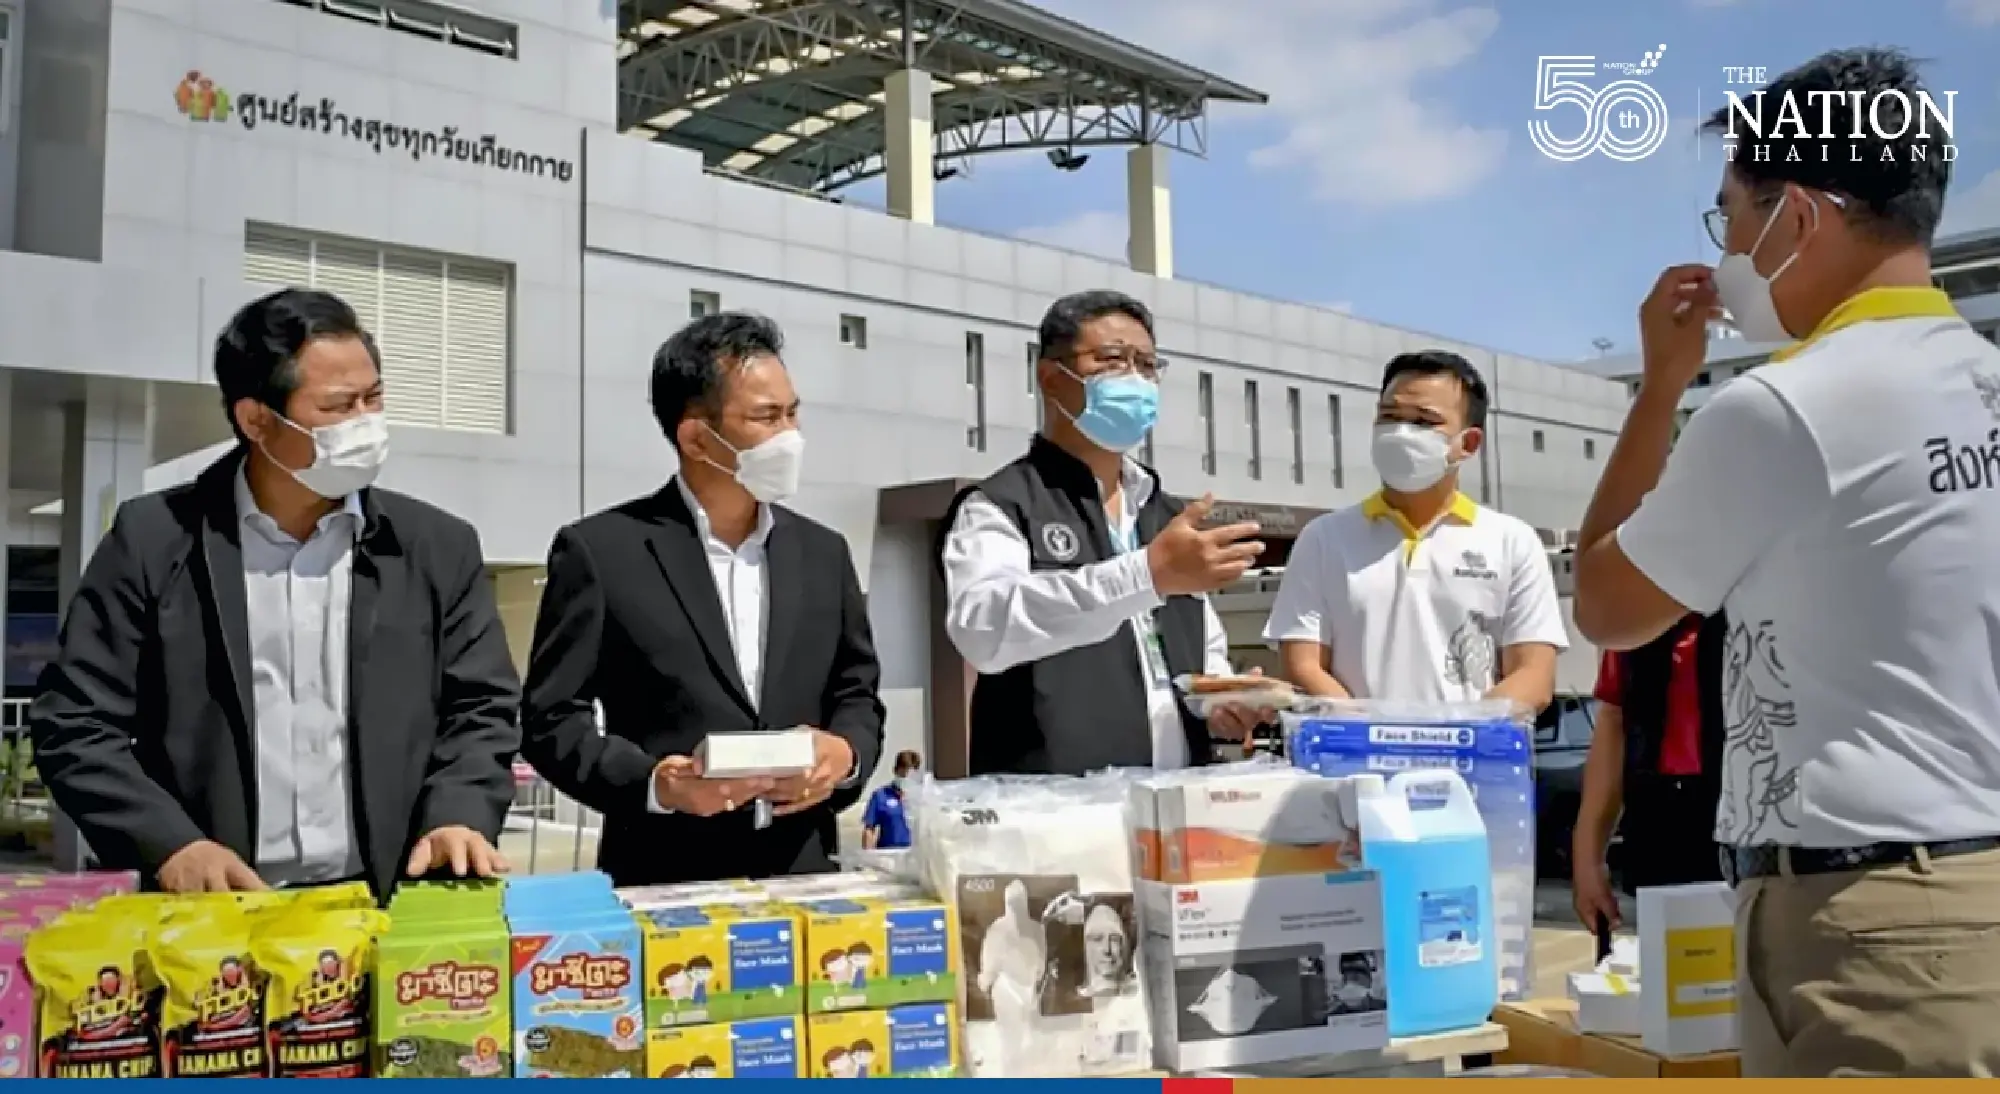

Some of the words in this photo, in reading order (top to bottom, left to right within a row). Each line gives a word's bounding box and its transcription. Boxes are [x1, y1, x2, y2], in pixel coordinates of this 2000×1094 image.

[1376, 728, 1407, 741] Face
[1411, 729, 1452, 744] Shield
[961, 808, 1001, 825] 3M
[177, 1050, 240, 1075] BANANA
[279, 1042, 340, 1064] BANANA
